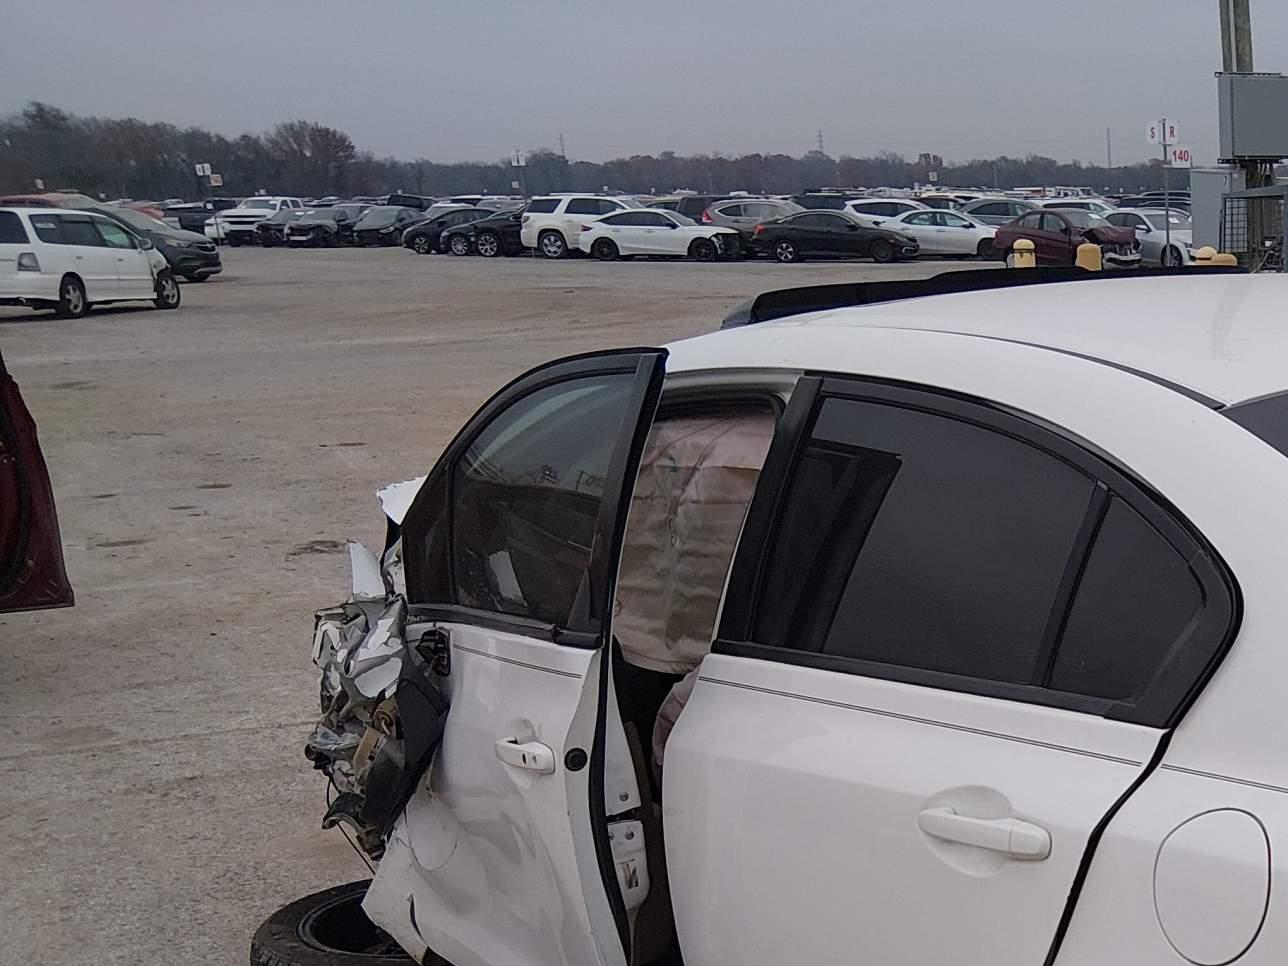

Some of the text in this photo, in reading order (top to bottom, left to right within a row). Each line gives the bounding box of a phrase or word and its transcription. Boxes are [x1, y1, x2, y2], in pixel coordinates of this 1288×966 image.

[1150, 126, 1156, 138] S
[1169, 126, 1175, 138] R
[1172, 150, 1188, 162] 140
